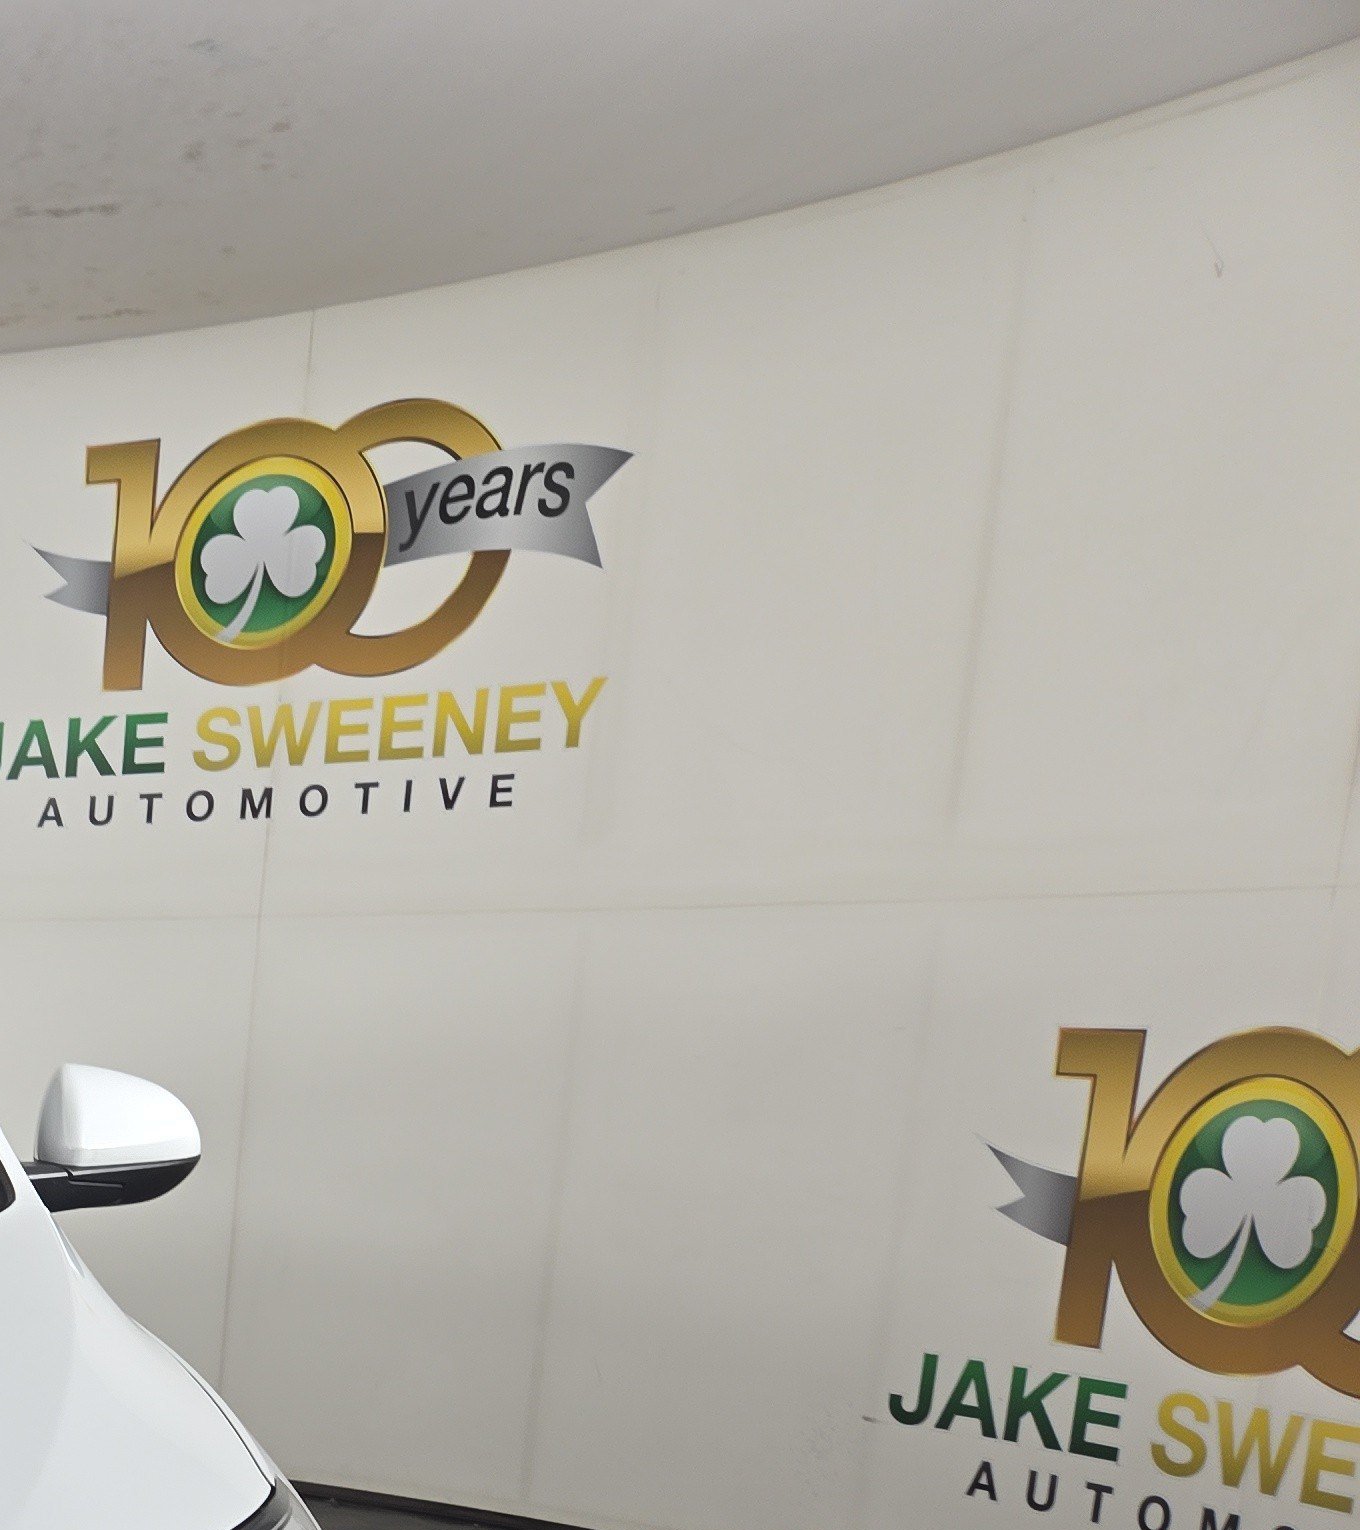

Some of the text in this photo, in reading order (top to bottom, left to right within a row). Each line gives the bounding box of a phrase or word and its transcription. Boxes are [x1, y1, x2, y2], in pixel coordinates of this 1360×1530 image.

[85, 398, 511, 692] 100
[399, 461, 574, 552] years
[192, 676, 608, 773] SWEENEY
[37, 773, 515, 829] AUTOMOTIVE
[1055, 1025, 1360, 1400] 10
[889, 1353, 1360, 1513] JAKE SWE
